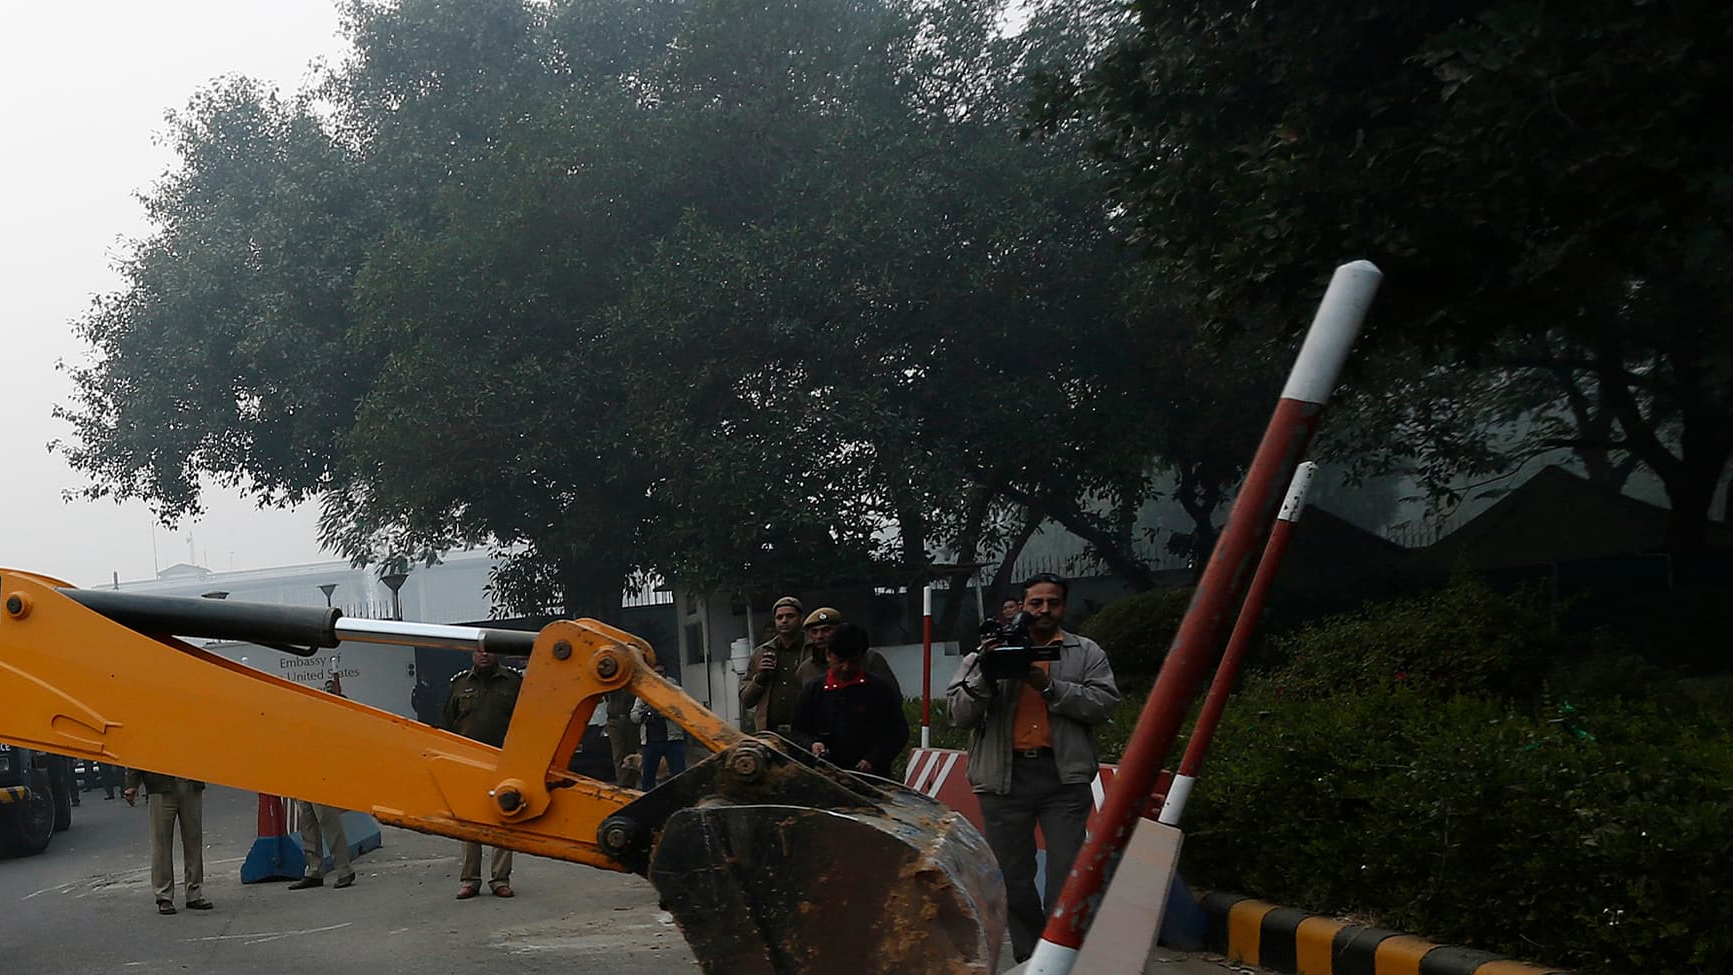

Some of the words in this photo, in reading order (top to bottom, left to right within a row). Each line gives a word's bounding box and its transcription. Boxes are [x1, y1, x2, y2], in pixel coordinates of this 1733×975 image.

[280, 656, 326, 669] Embassy
[287, 669, 324, 682] United
[327, 668, 360, 680] Sates
